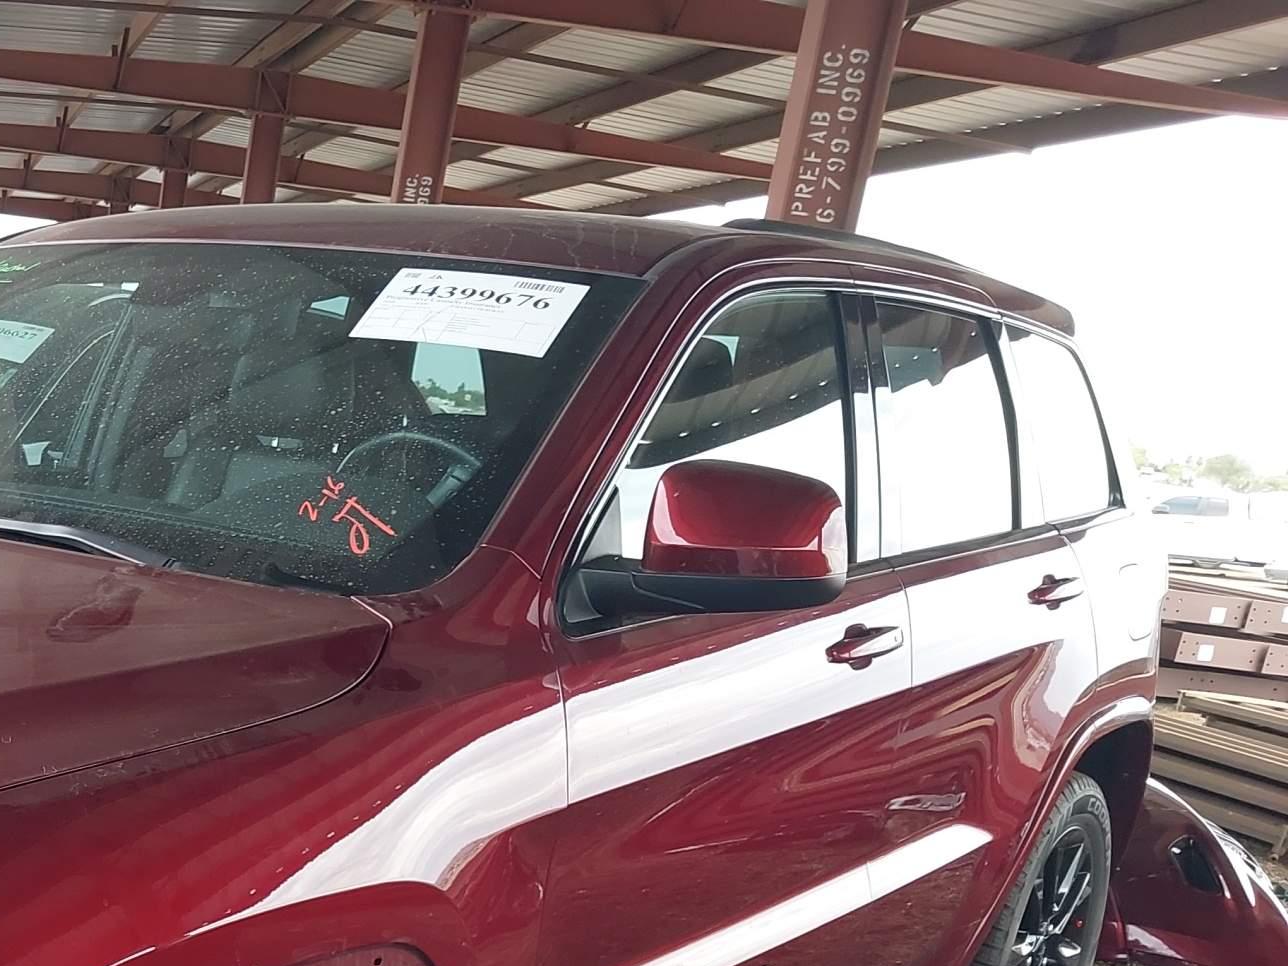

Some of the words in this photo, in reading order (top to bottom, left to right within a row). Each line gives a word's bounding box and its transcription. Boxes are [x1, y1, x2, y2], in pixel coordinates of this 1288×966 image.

[790, 111, 831, 217] PREFAB
[815, 44, 847, 95] INC.
[815, 48, 870, 223] 6-799-0969
[402, 284, 553, 310] 44399676
